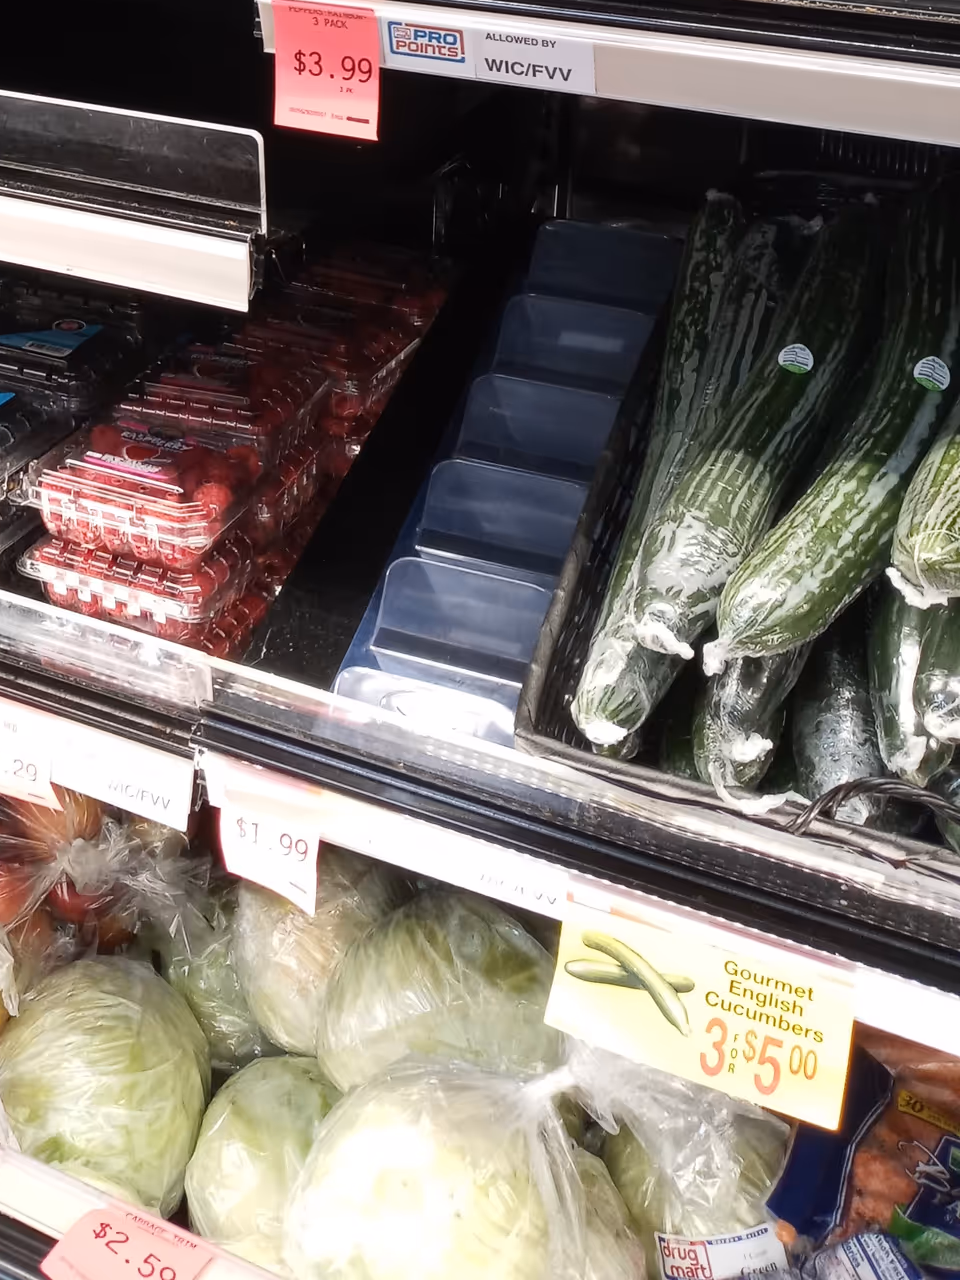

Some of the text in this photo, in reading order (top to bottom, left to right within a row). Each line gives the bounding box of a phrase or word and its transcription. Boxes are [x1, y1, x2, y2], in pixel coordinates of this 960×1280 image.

[312, 17, 349, 29] 3 PACK
[412, 30, 458, 45] PRO
[485, 32, 557, 49] ALLOWED BY
[293, 49, 373, 83] $3.99
[484, 57, 573, 82] WIC/FVV
[236, 817, 309, 862] $1.99
[724, 960, 815, 1002] Gourmet
[729, 979, 804, 1017] English
[705, 991, 824, 1043] Cucumbers
[700, 1017, 728, 1077] 3
[662, 1239, 699, 1266] drug
[669, 1263, 708, 1279] mart
